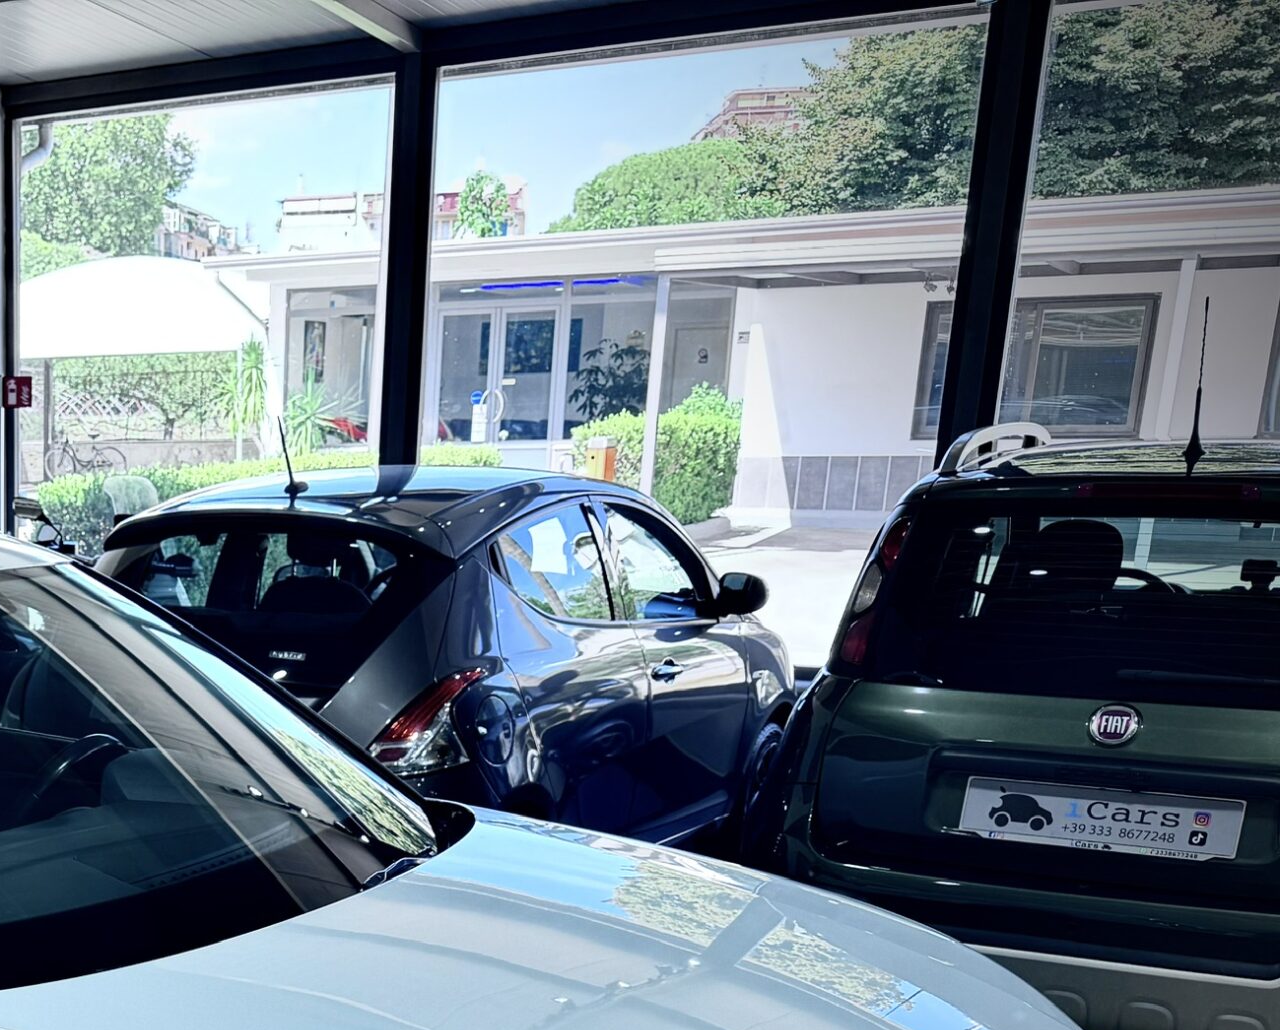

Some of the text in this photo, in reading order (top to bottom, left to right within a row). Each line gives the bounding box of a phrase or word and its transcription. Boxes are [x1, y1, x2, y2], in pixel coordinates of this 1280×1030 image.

[1100, 715, 1130, 734] FIAT
[1061, 822, 1176, 844] +39 333 8677248
